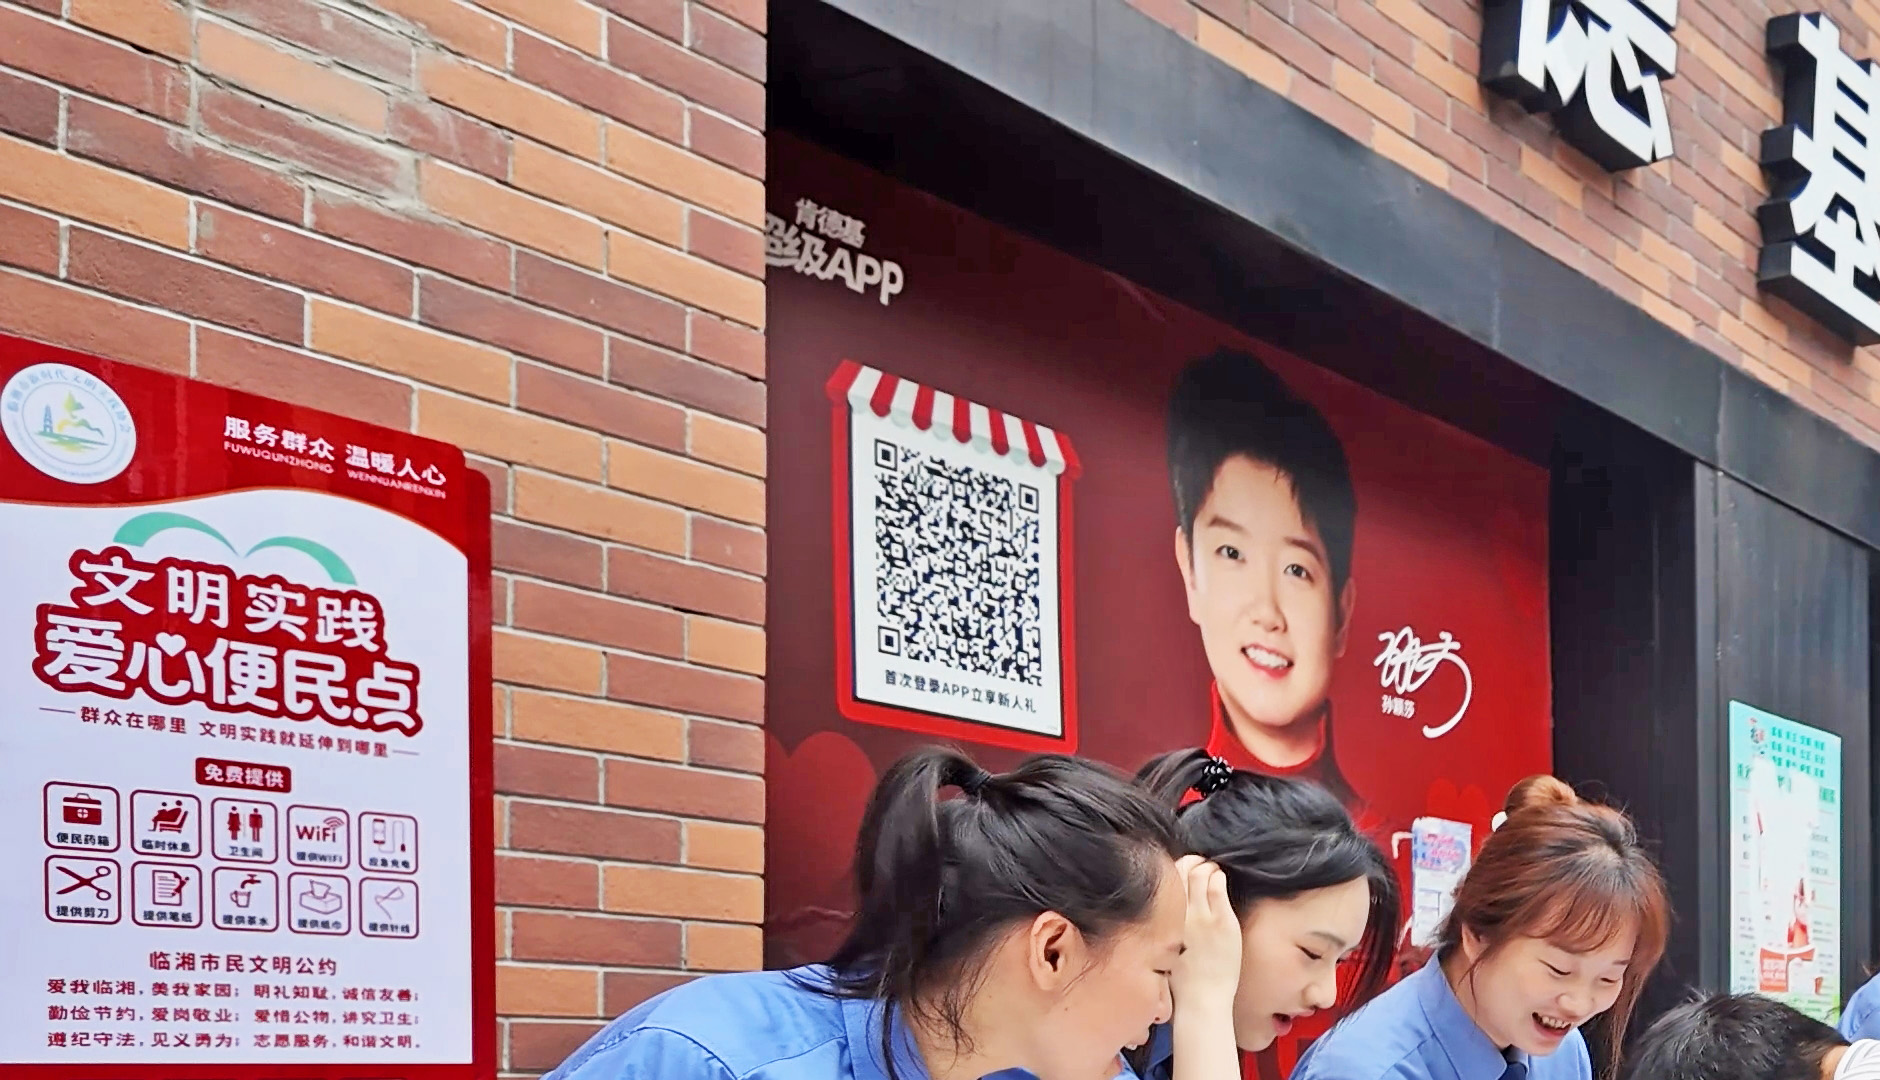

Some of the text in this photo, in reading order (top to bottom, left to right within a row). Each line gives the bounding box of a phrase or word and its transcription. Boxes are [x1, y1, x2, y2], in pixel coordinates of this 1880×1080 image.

[224, 415, 447, 486] 服务群众 温暖人心
[80, 556, 382, 652] 文明实践
[43, 612, 422, 730] 爱心便民点
[80, 706, 389, 759] 群众在哪里 文明实践就延伸到哪里
[204, 763, 284, 789] 免费提供
[56, 832, 110, 847] 便民药箱
[296, 823, 337, 844] WiFi
[141, 839, 191, 853] 临时休息
[228, 845, 264, 859] 卫生间
[56, 905, 110, 919] 提供剪刀
[143, 910, 193, 923] 提供笔纸
[149, 951, 338, 976] 临湘市民文明公约
